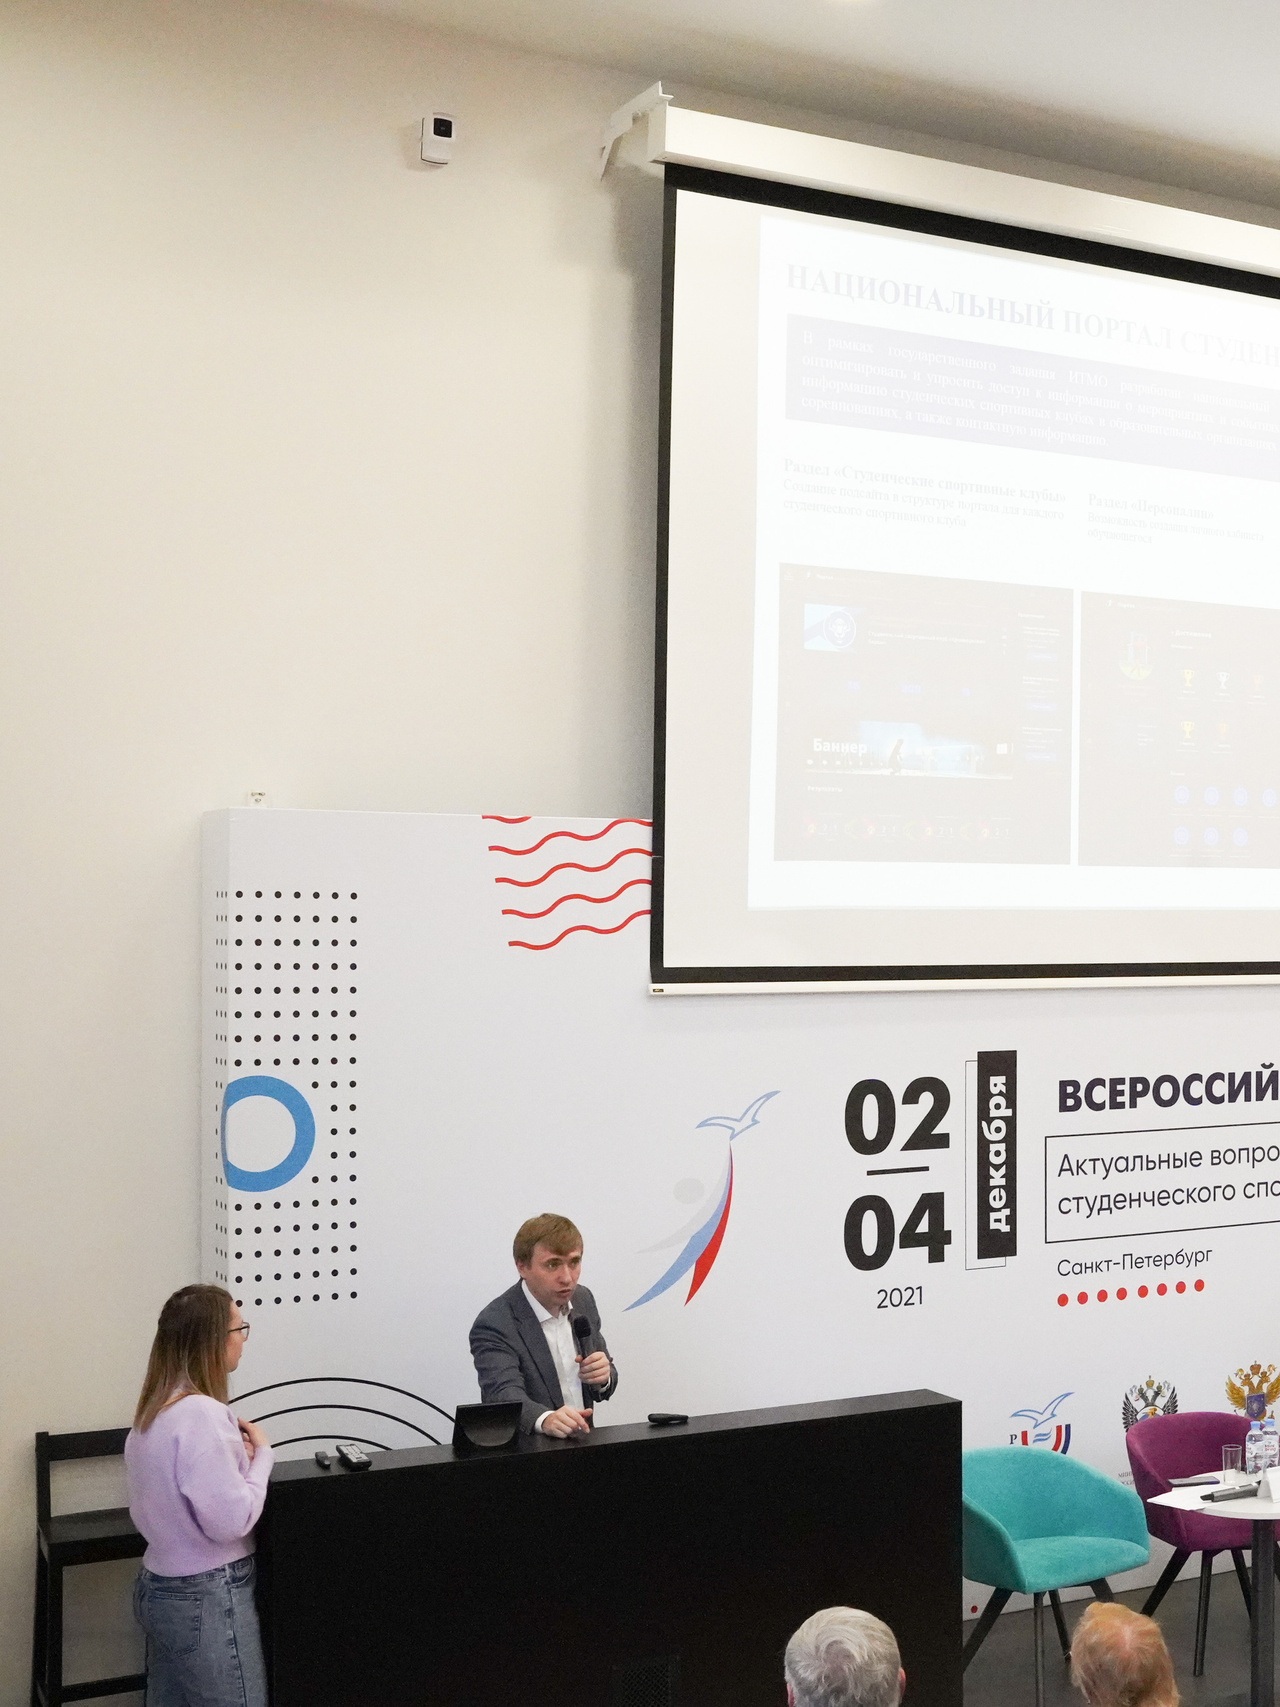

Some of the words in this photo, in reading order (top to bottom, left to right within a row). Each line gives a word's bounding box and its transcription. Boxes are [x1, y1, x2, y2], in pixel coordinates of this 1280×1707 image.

[787, 265, 1054, 329] НАЦИОНАЛЬНЫЙ
[1064, 310, 1171, 349] ПОРТАЛ
[784, 458, 830, 477] Раздел
[834, 465, 934, 488] «Студенческие
[938, 479, 1016, 497] спортивные
[1019, 487, 1066, 504] клубы»
[813, 737, 868, 757] Баннер
[845, 1077, 950, 1155] 02
[982, 1075, 1012, 1232] декабря
[1058, 1151, 1202, 1179] Актуальные
[1059, 1185, 1235, 1217] студенческого
[844, 1192, 951, 1271] 04
[1058, 1249, 1212, 1276] Санкт-Петербург
[877, 1286, 922, 1308] 2021
